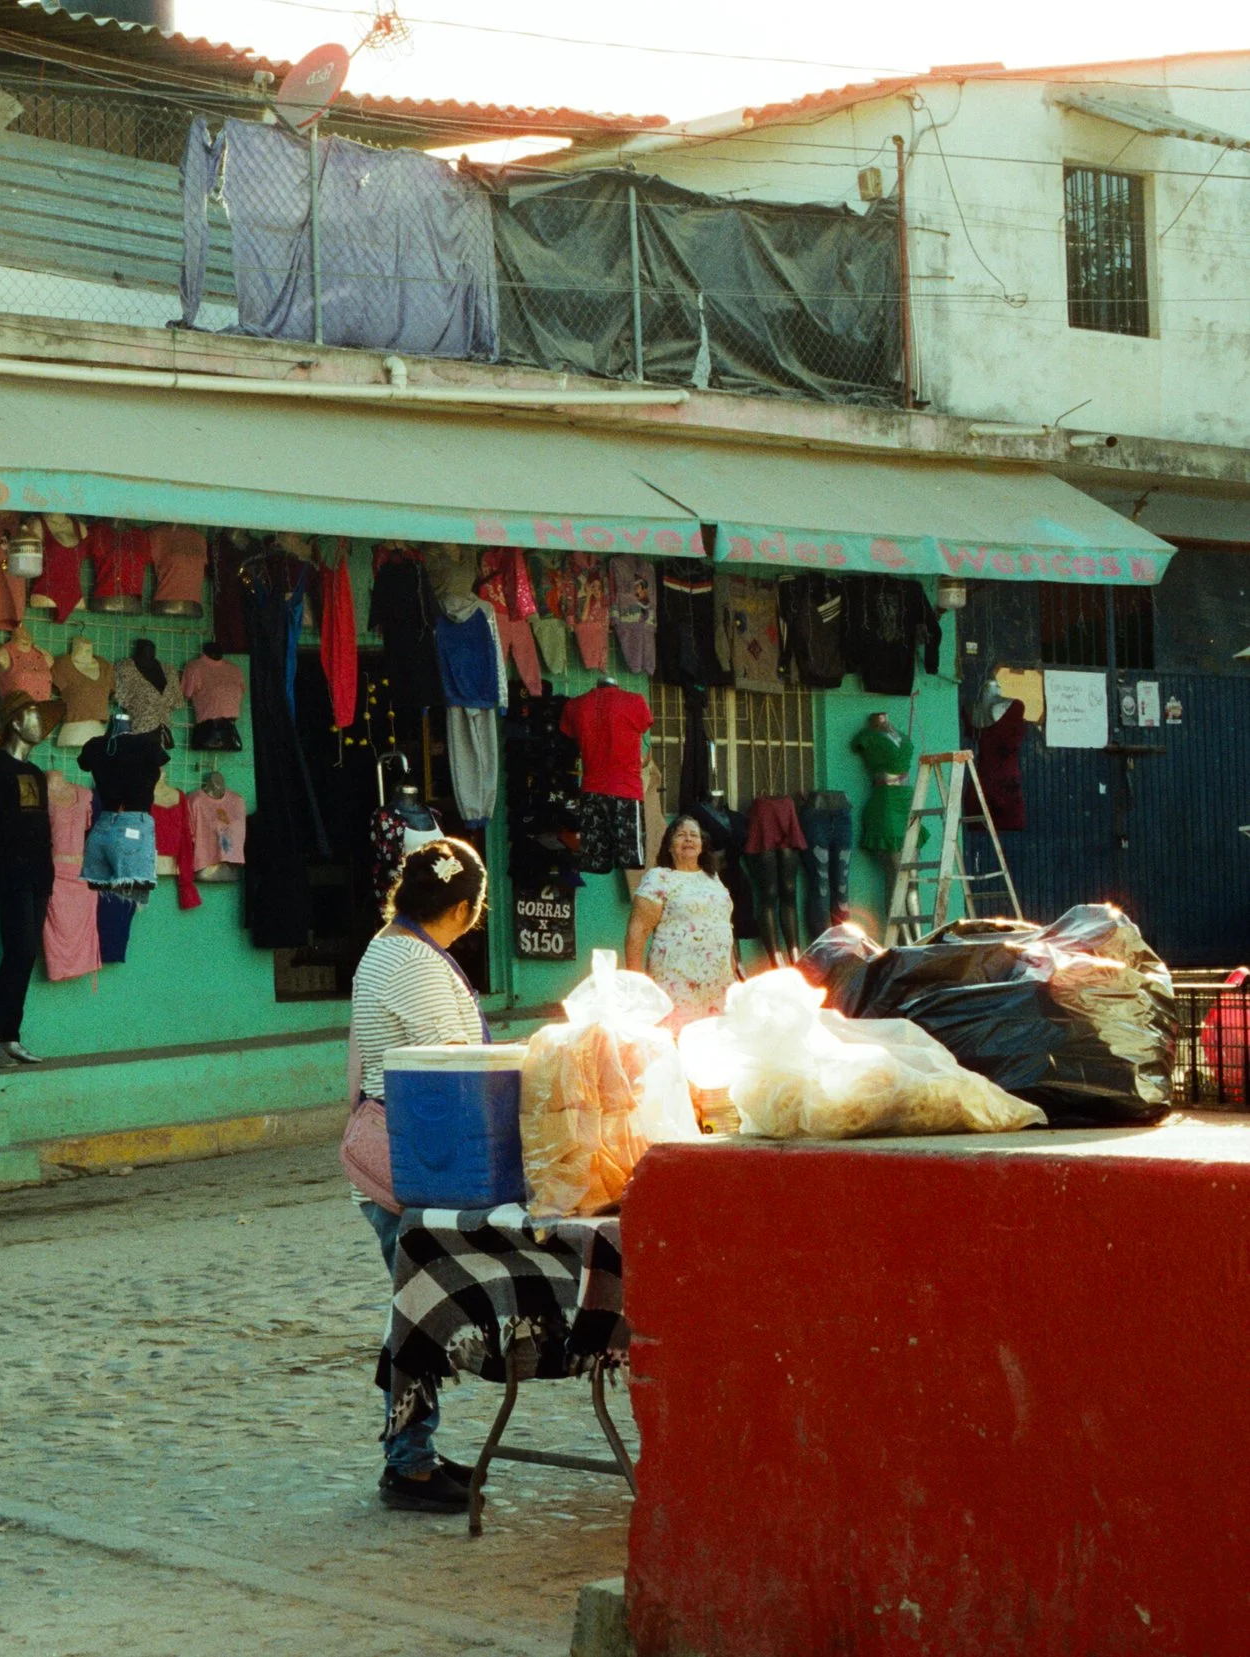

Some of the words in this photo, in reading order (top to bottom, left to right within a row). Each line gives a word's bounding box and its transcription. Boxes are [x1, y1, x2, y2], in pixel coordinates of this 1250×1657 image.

[937, 543, 1122, 577] Wences
[517, 900, 570, 919] GORRAS
[519, 928, 564, 954] $150
